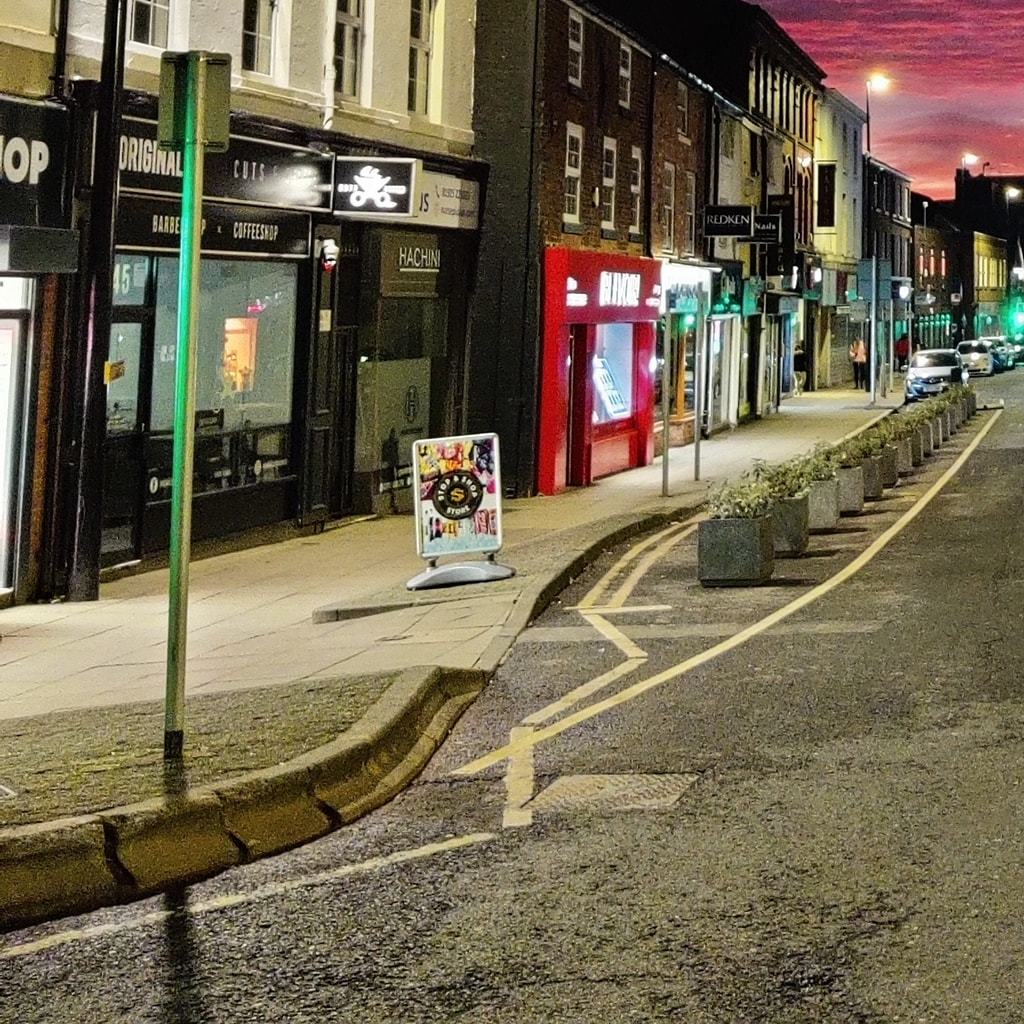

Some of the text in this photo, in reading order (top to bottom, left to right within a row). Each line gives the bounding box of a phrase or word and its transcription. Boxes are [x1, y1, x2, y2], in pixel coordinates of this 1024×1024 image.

[0, 135, 50, 184] OP
[233, 159, 265, 182] CUTS
[706, 214, 750, 225] REDKEN
[233, 221, 279, 241] COFFEESHOP
[399, 247, 441, 268] HACHINI
